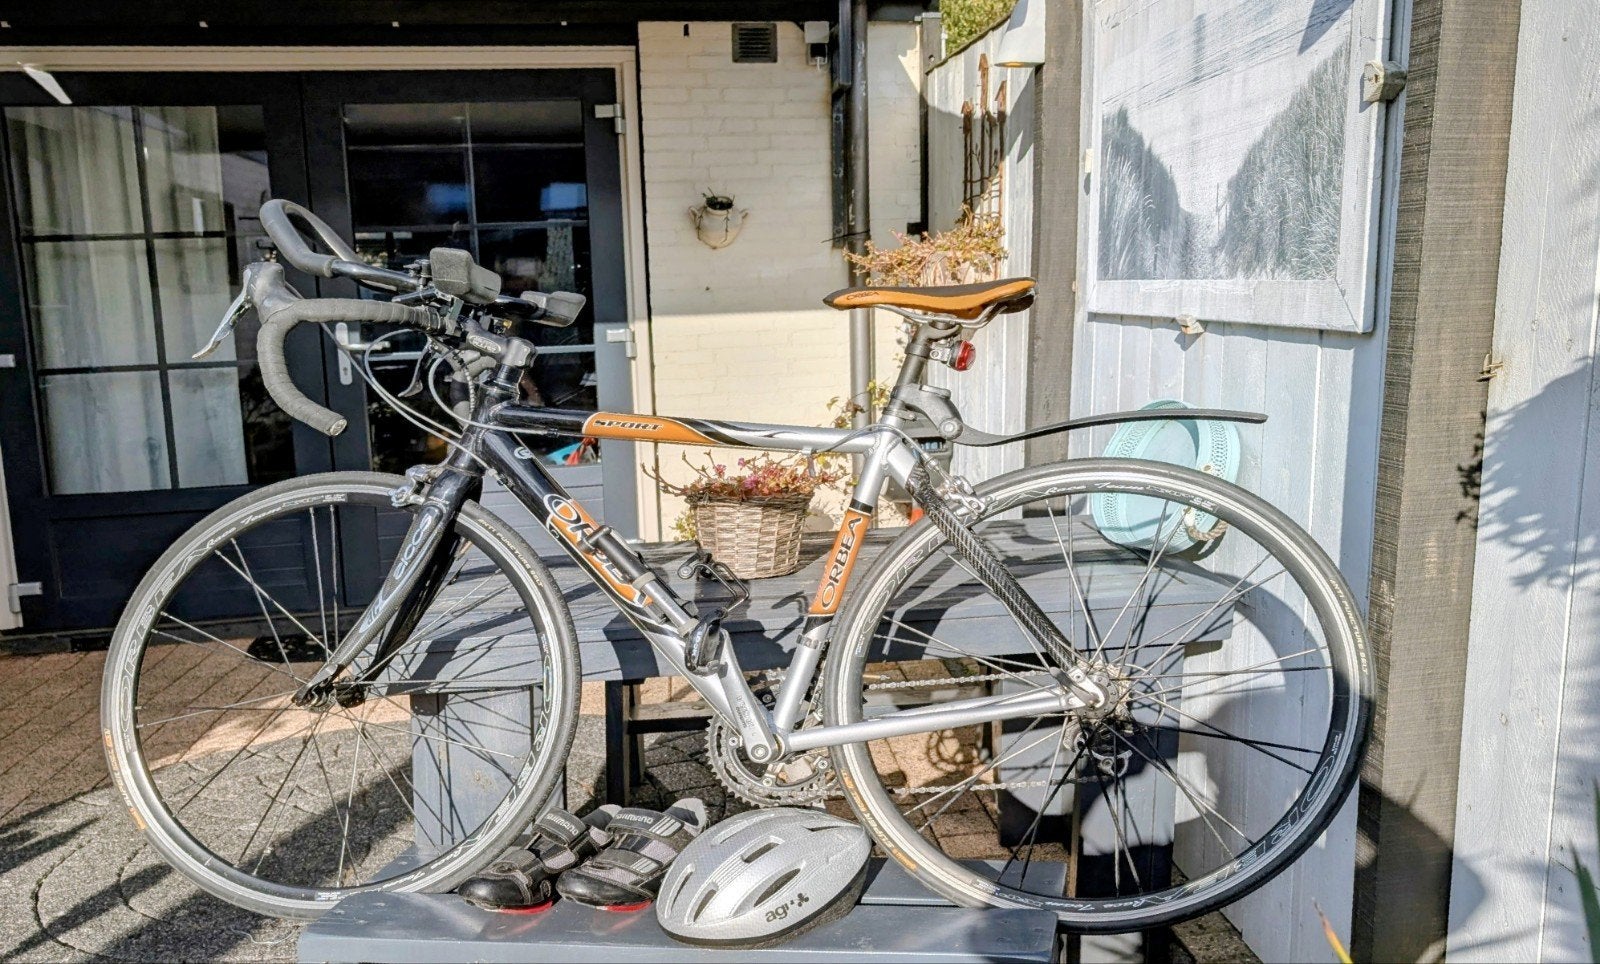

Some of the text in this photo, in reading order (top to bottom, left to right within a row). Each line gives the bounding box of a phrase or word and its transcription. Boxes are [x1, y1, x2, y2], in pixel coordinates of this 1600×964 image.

[846, 290, 880, 300] ORBEA
[594, 418, 663, 432] SPORT
[477, 518, 544, 588] ANTI PUNCTURE BELT
[822, 517, 862, 610] ORBEA
[120, 547, 209, 732] ORBEA
[1330, 578, 1368, 674] ANTI PUNCTURE BELT
[460, 655, 553, 847] ORBEA
[547, 812, 579, 835] SHIMANO
[615, 813, 654, 824] SHIMANO
[1144, 756, 1335, 905] ORBEA
